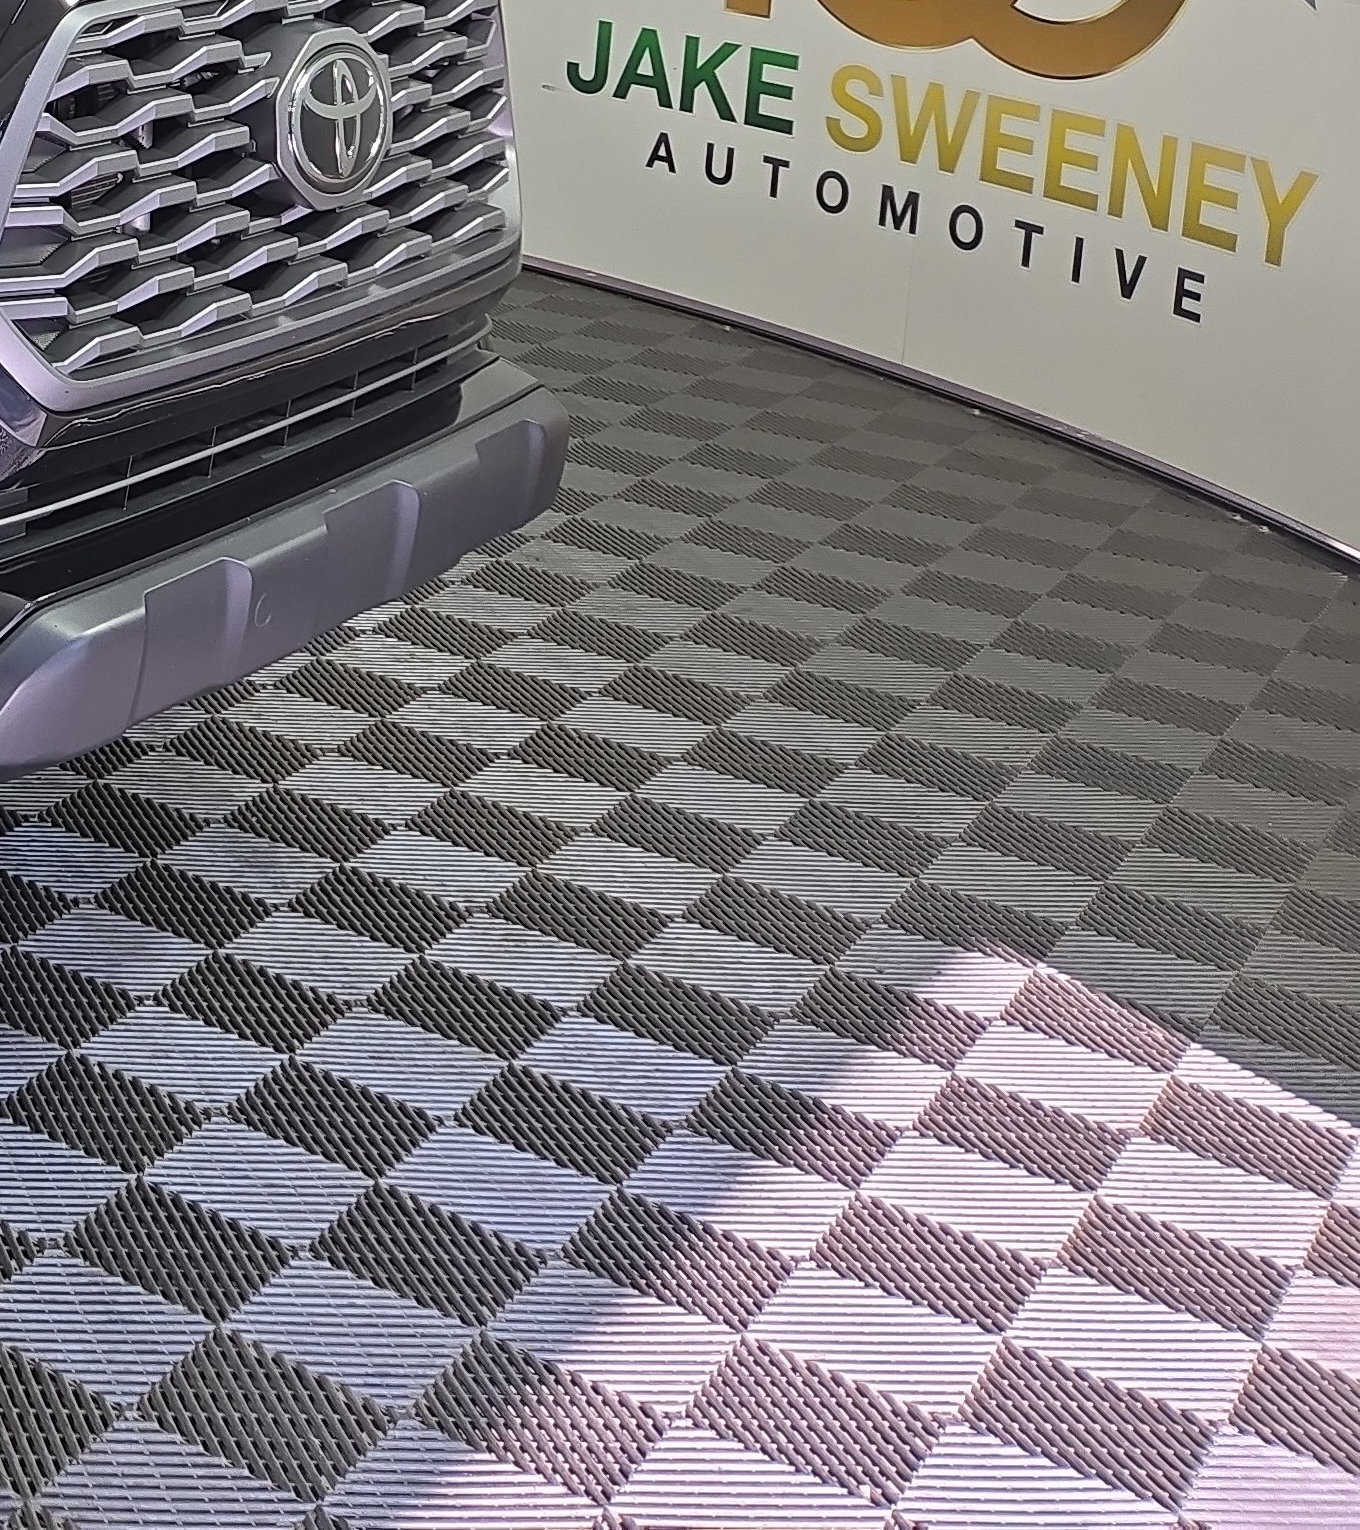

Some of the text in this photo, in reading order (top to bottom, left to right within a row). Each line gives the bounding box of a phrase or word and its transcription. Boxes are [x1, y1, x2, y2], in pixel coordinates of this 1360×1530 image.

[566, 19, 1320, 269] JAKE SWEENEY
[645, 131, 1206, 323] AUTOMOTIVE
